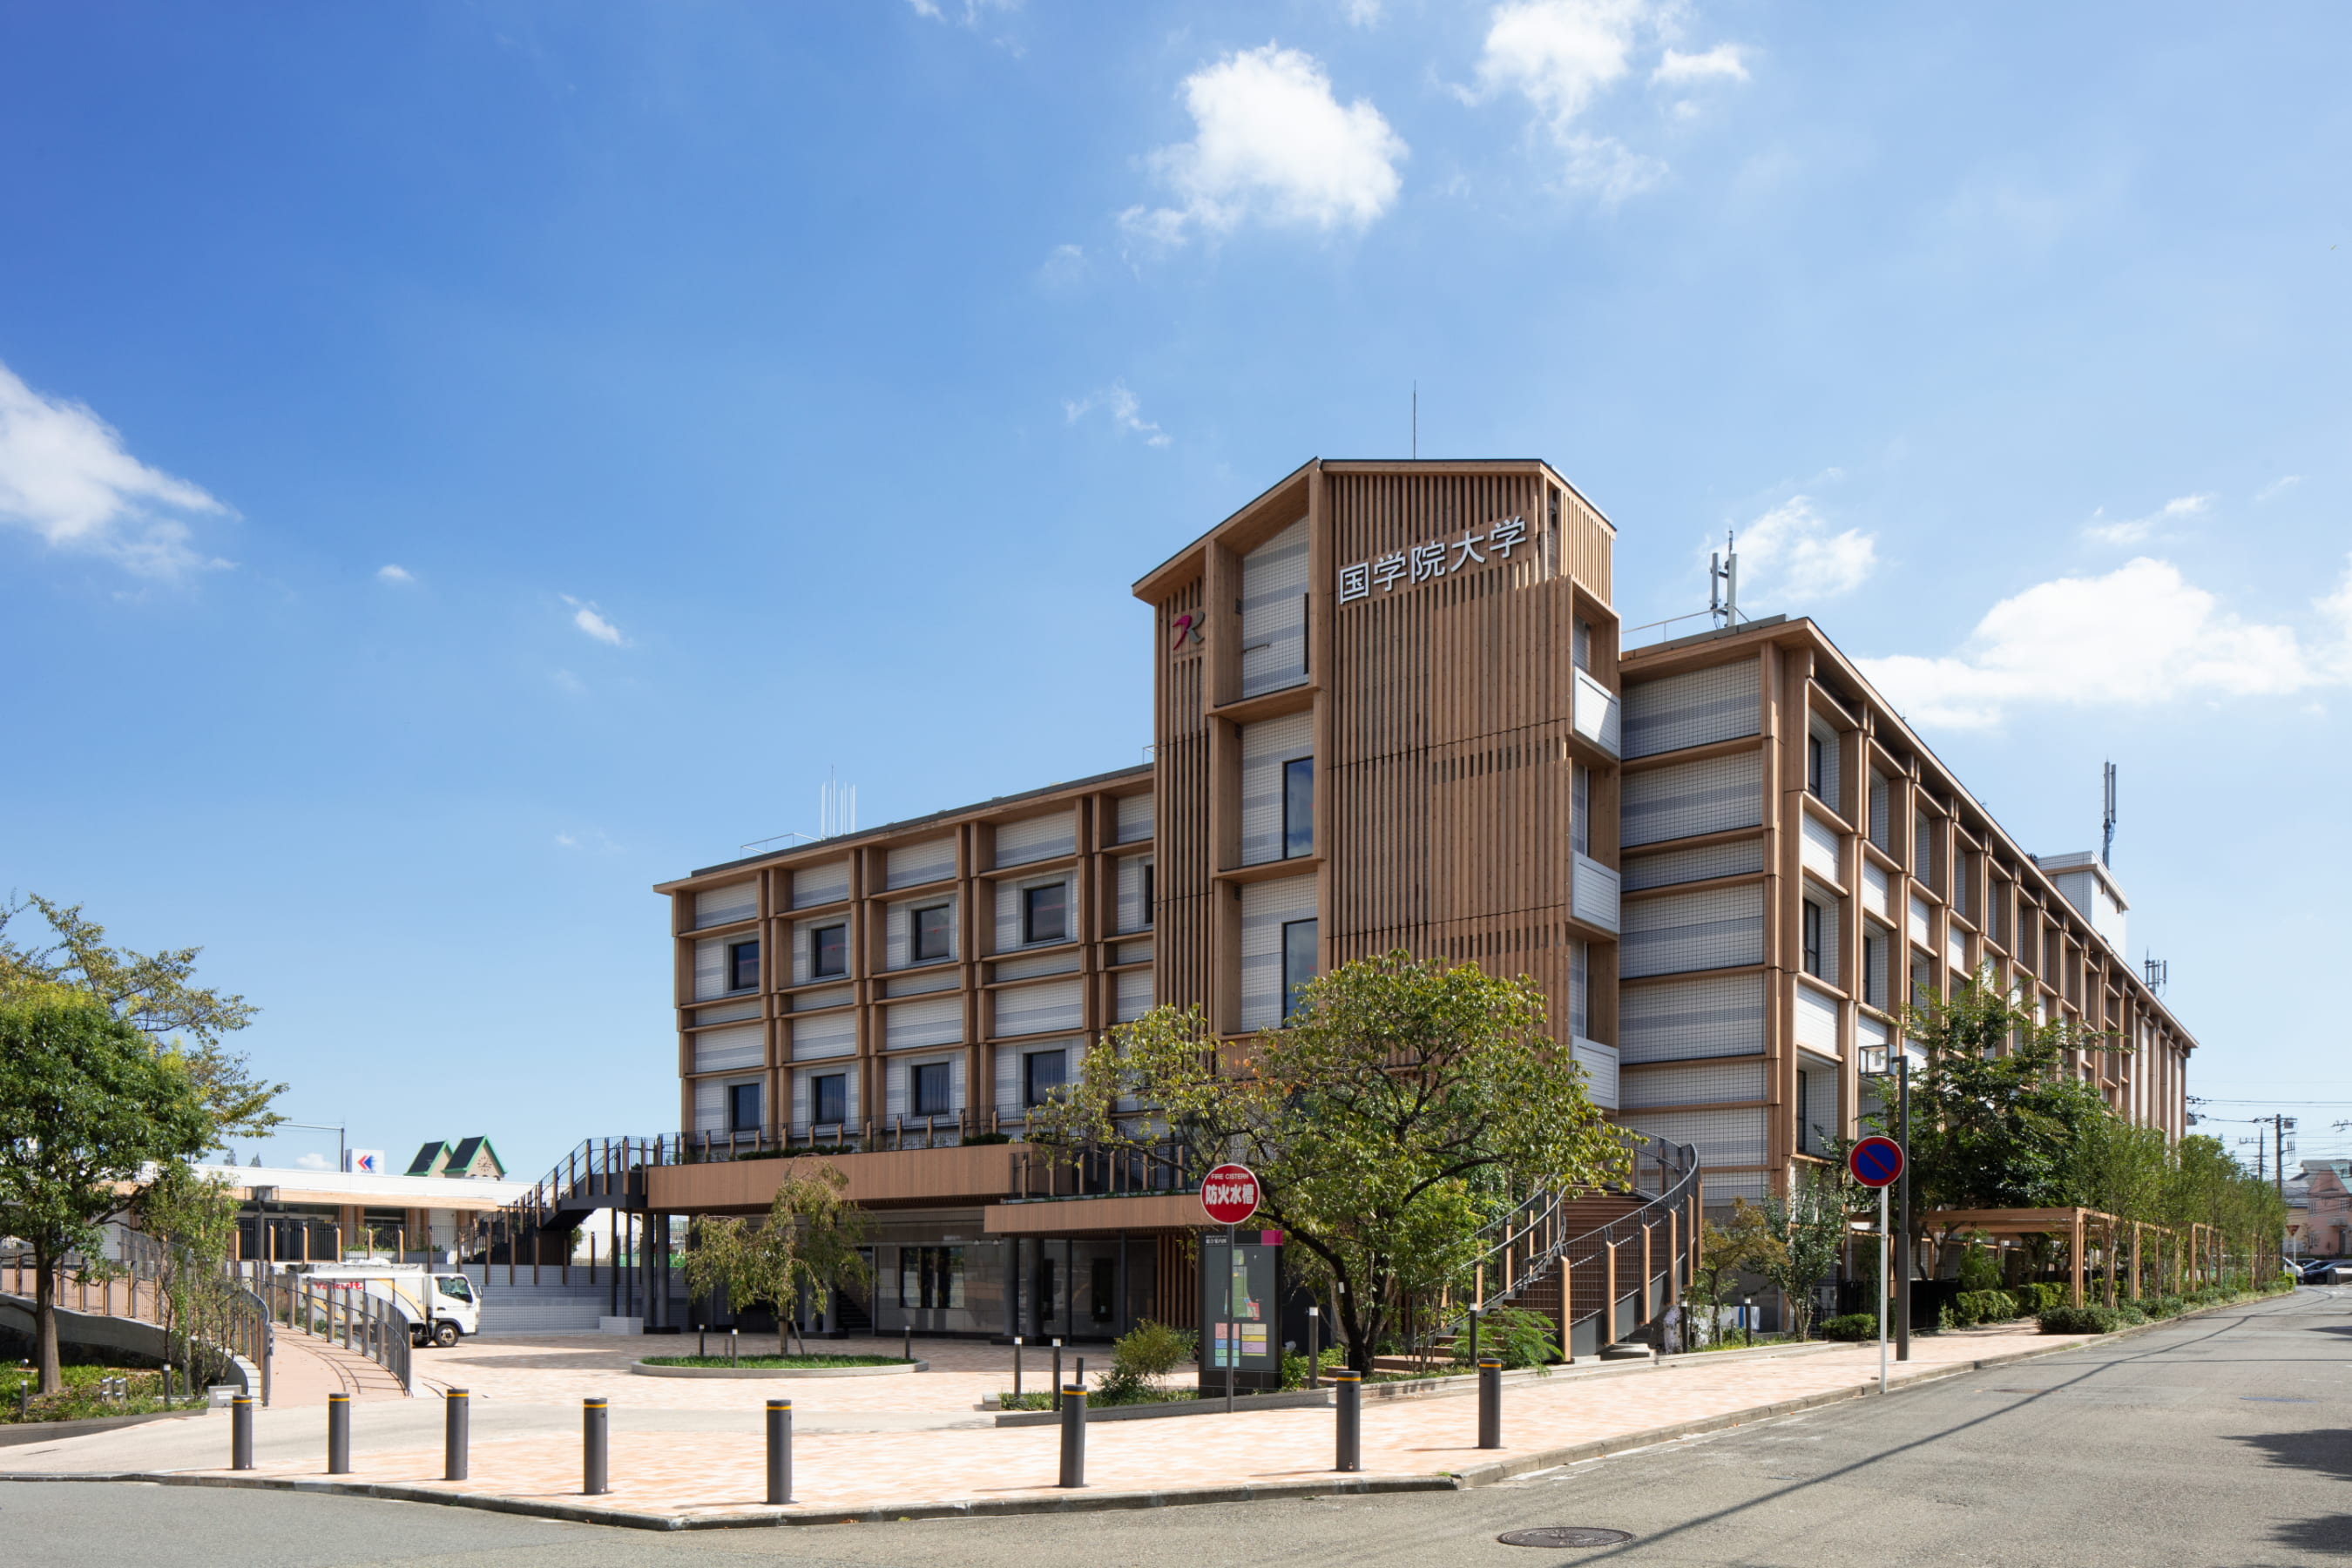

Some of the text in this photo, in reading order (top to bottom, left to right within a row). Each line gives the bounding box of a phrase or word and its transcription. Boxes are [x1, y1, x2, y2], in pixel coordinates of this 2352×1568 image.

[1339, 516, 1527, 605] 国学院大学
[1206, 1184, 1254, 1205] 防火水槽
